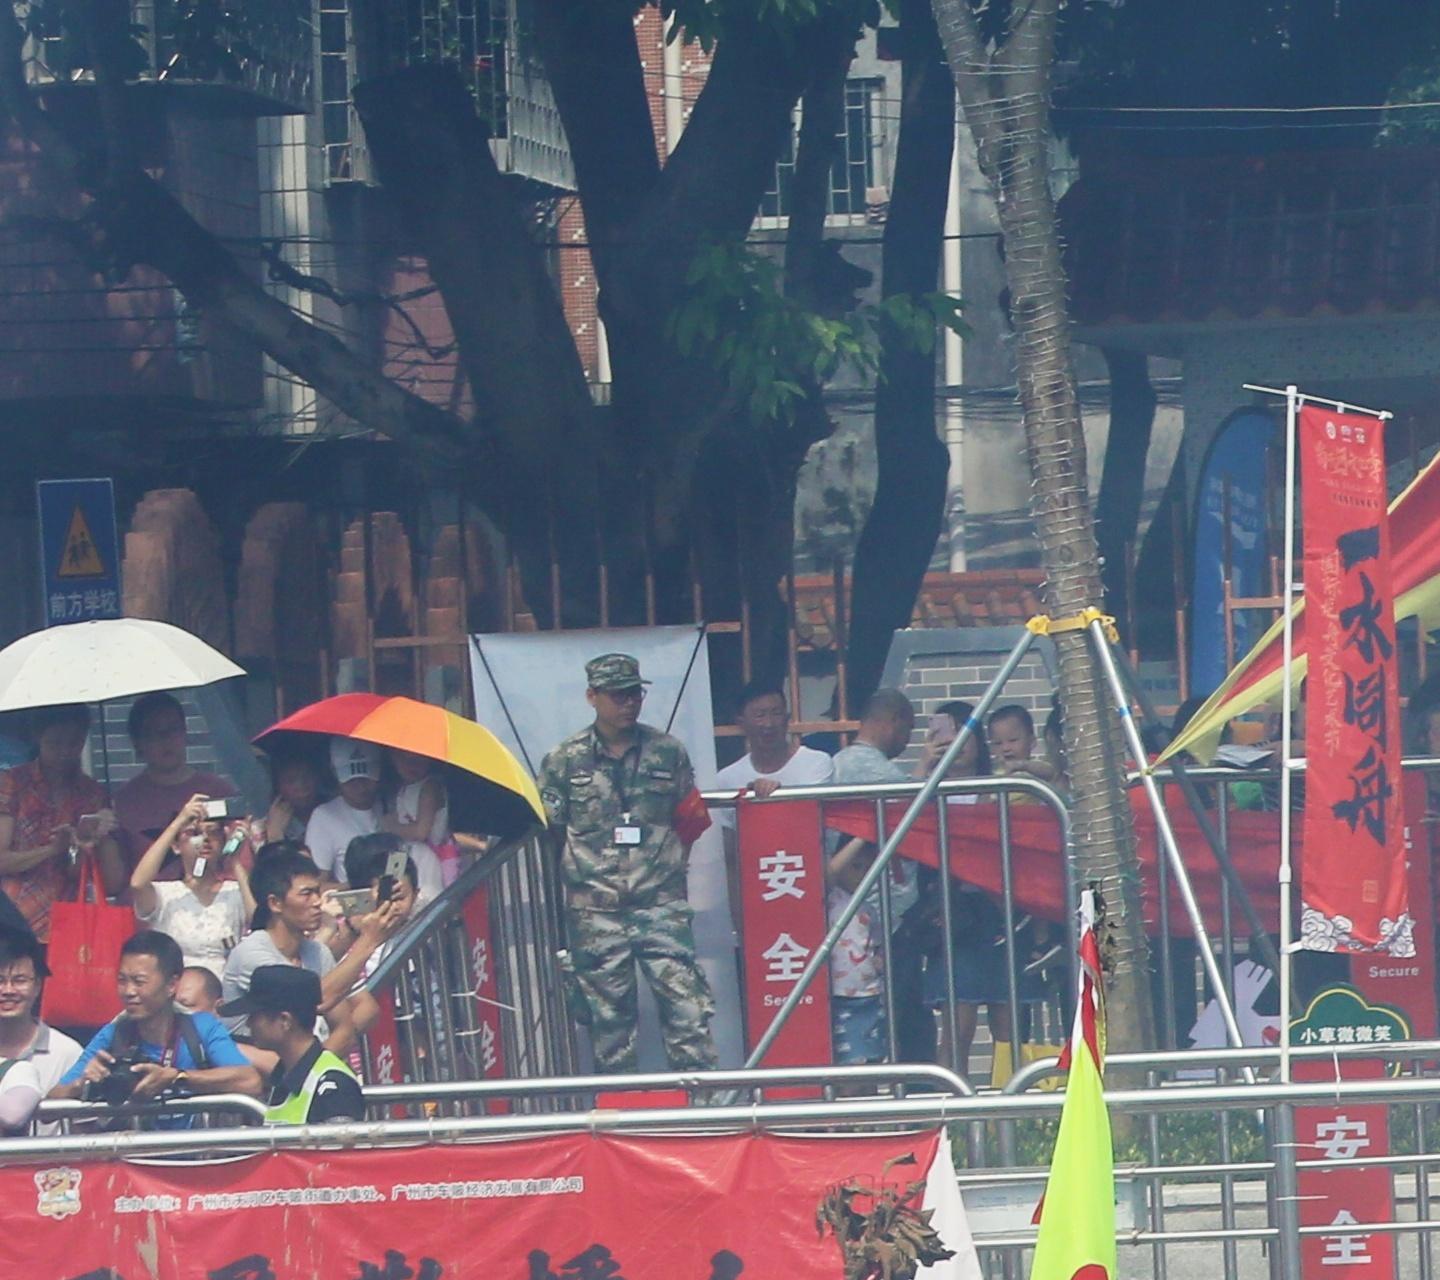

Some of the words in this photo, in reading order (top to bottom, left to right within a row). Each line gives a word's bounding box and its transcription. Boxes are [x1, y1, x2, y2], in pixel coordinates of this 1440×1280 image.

[50, 589, 118, 618] 前方学校
[1331, 531, 1393, 848] 一水同舟
[758, 851, 811, 982] 安全
[1368, 966, 1420, 978] Secure
[1300, 1025, 1392, 1043] 小草微微笑
